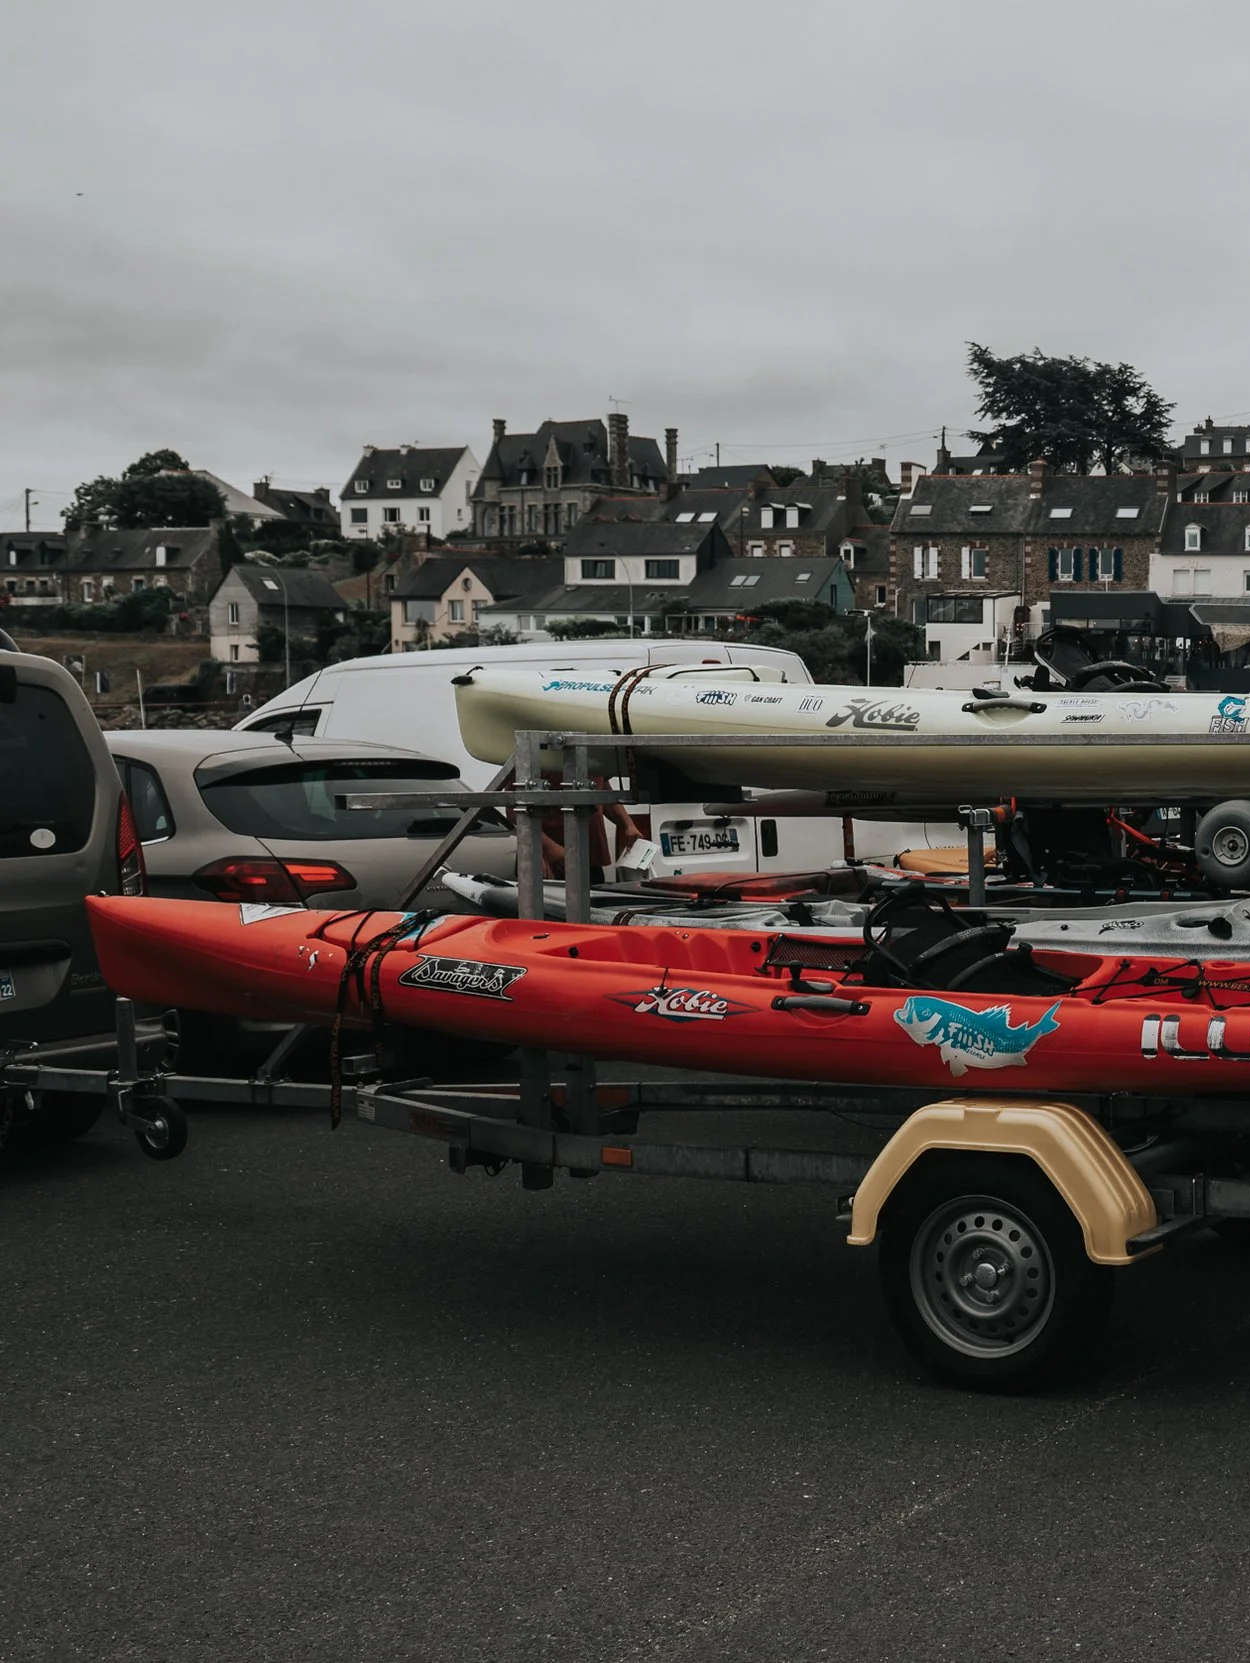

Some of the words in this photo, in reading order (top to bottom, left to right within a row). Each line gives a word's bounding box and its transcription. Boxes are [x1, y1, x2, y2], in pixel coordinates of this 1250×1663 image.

[764, 696, 783, 704] CRAFT
[825, 698, 921, 731] Hobie
[1, 984, 13, 996] 22
[631, 986, 730, 1021] Hobie
